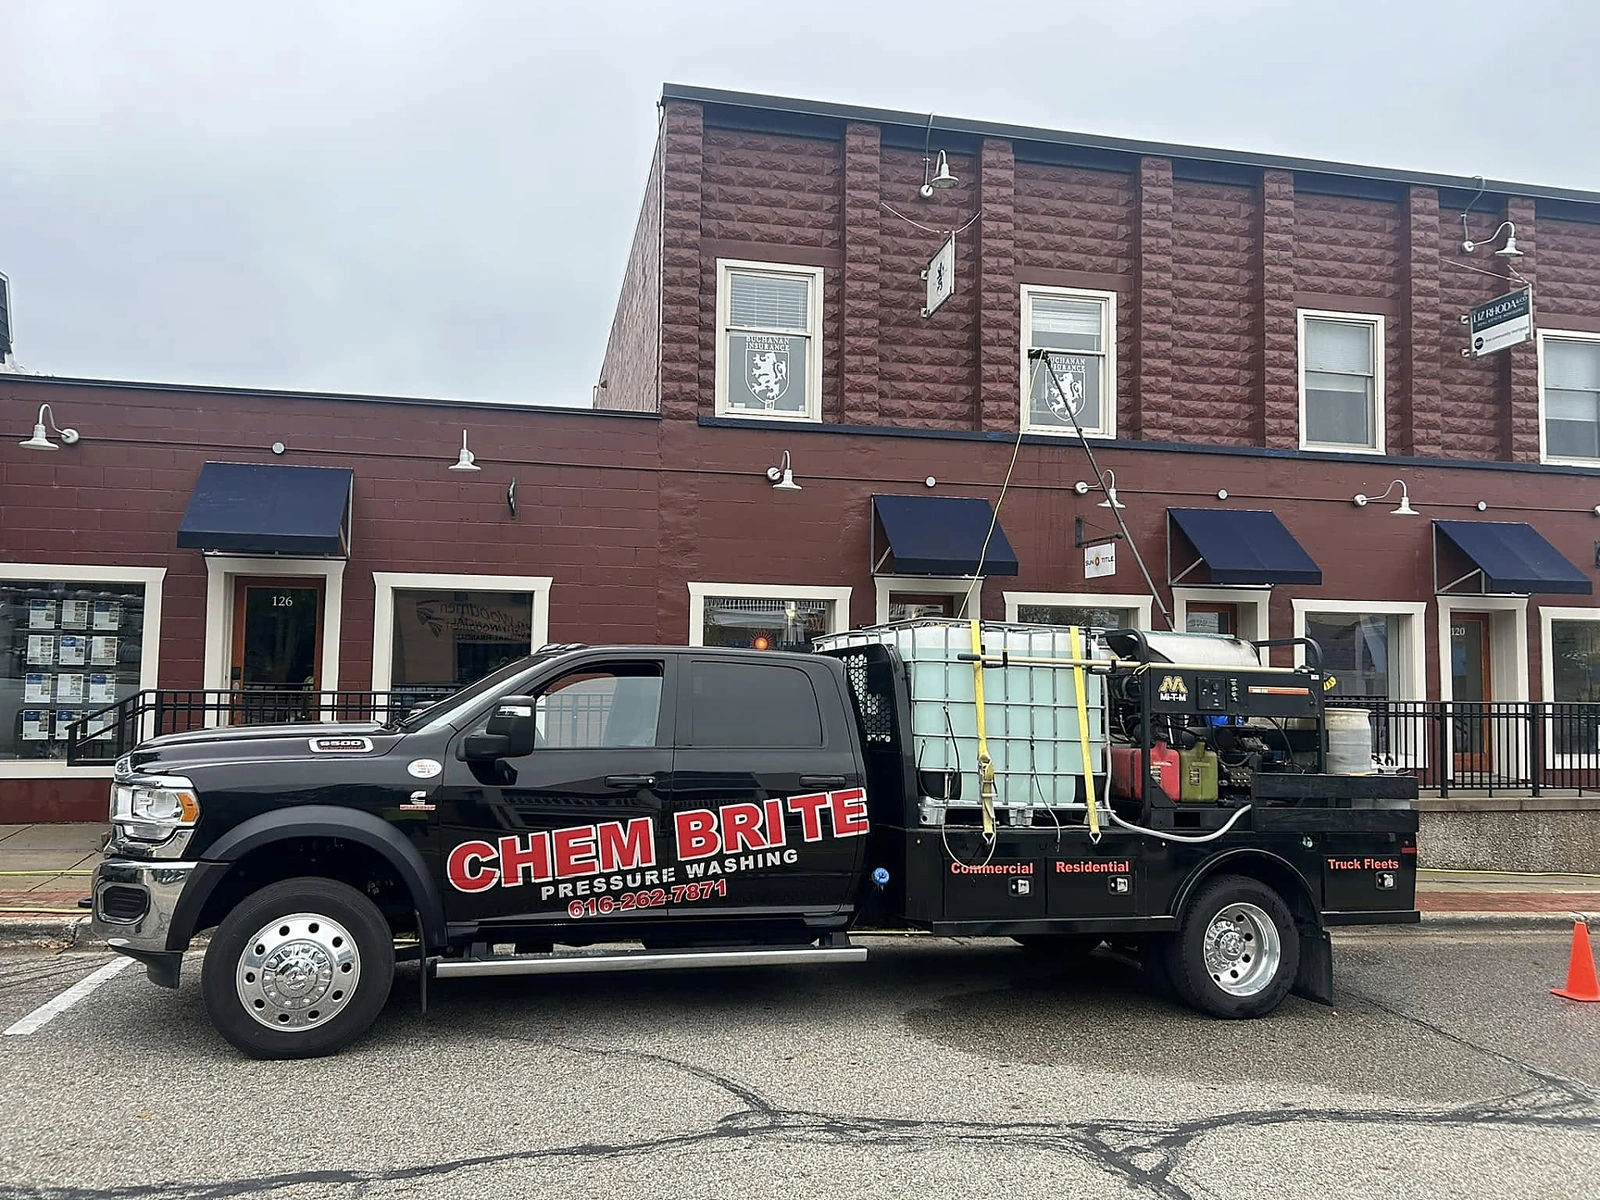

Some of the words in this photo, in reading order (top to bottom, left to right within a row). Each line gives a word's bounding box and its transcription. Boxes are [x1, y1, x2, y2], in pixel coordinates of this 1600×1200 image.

[1473, 311, 1485, 323] LIZ
[1485, 299, 1517, 318] RHODA
[746, 335, 789, 344] BUCHANAN
[746, 342, 789, 351] INSURANCE
[1101, 555, 1114, 563] TITLE
[272, 595, 293, 607] 126
[1451, 626, 1466, 636] 120
[447, 816, 657, 893] CHEM
[673, 786, 870, 861] BRITE
[950, 862, 1034, 875] Commercial
[1055, 860, 1130, 873] Residential
[1327, 858, 1361, 870] Truck
[1363, 858, 1399, 870] Fleets
[541, 867, 676, 900] PRESSURE
[685, 848, 799, 879] WASHING
[568, 878, 727, 919] 616-262-7871
